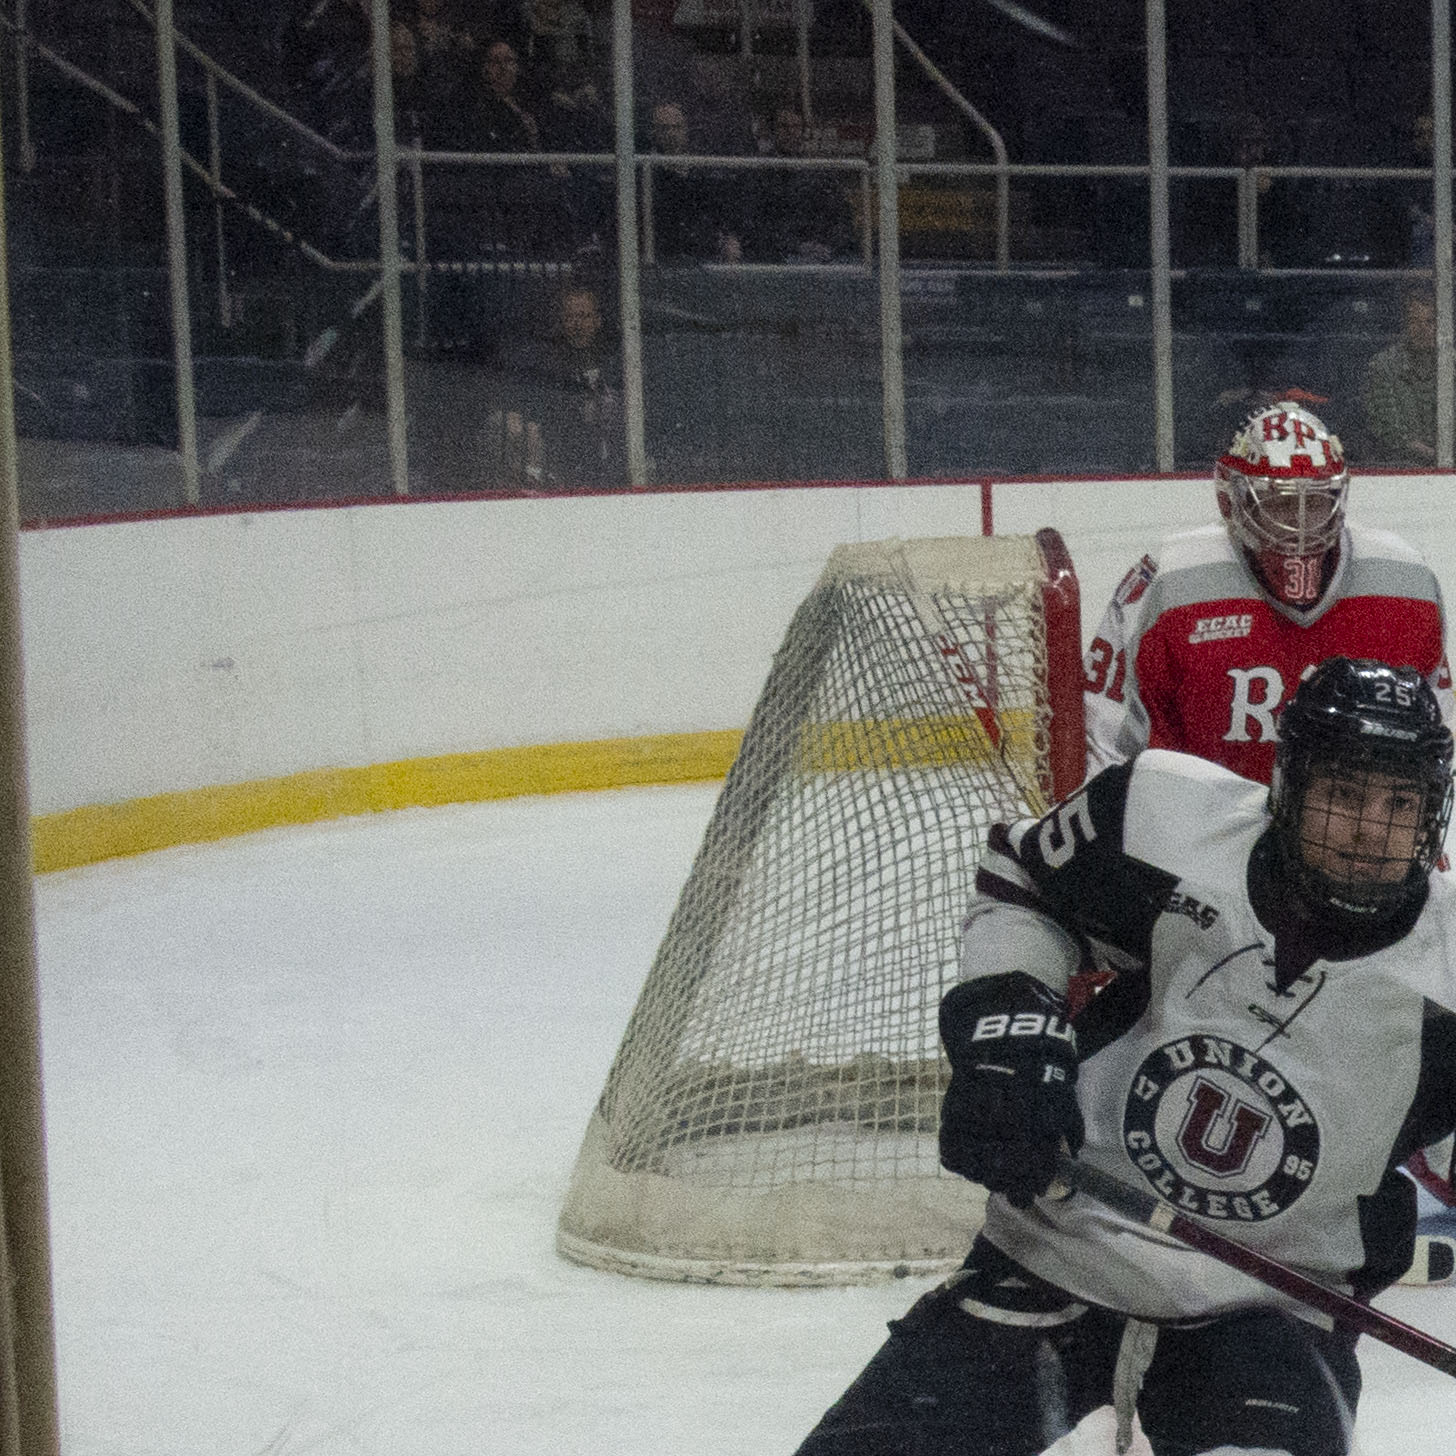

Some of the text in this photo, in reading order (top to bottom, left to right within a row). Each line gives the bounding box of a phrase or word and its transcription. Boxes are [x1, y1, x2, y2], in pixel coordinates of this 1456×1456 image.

[1284, 557, 1323, 600] 31
[1195, 614, 1253, 634] ECAC
[1082, 635, 1127, 703] 31
[1374, 681, 1412, 707] 25
[1163, 1037, 1315, 1128] UNION
[1175, 1074, 1274, 1180] U
[1127, 1130, 1280, 1219] COLLEGE
[1282, 1154, 1314, 1182] 95
